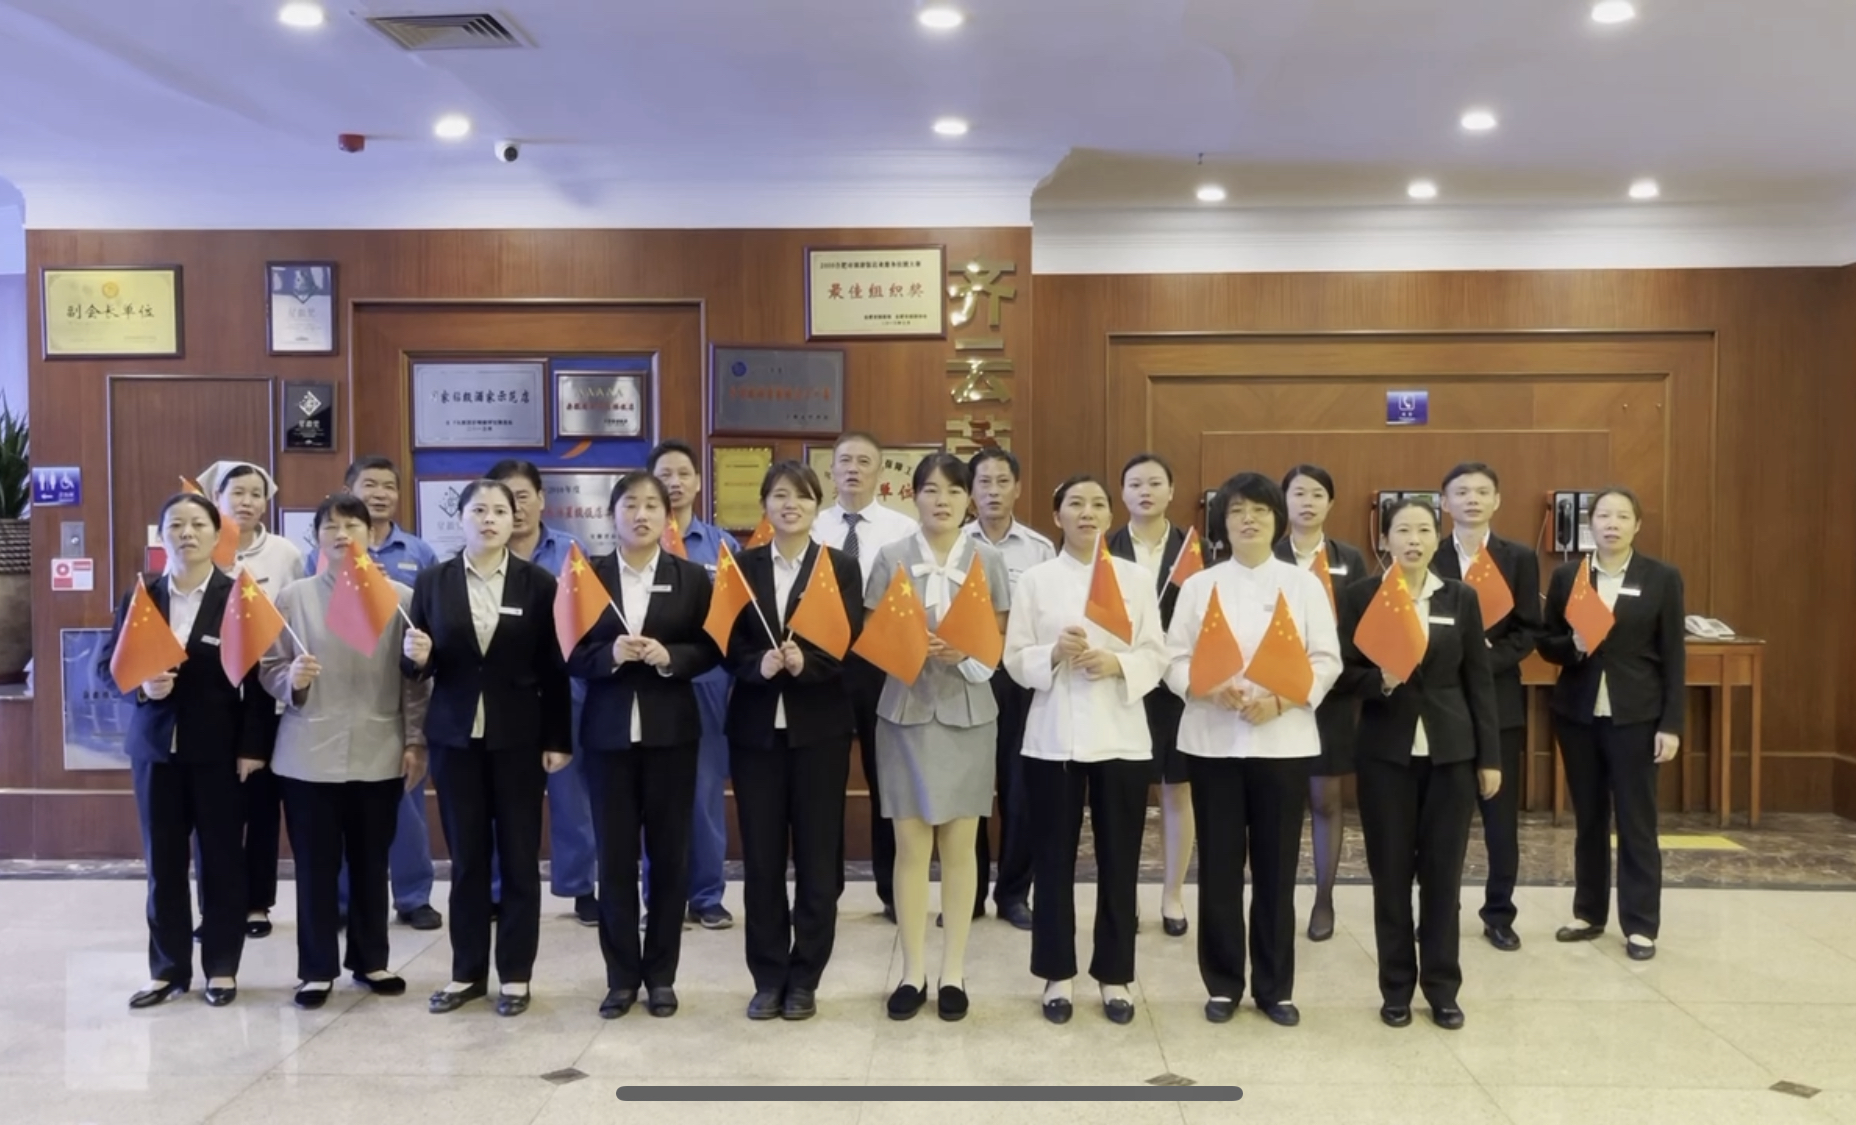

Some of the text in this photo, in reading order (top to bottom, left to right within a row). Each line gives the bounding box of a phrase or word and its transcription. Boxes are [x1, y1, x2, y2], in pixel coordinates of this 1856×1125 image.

[828, 282, 925, 300] 最佳组织奖
[66, 303, 156, 320] 副会长单位
